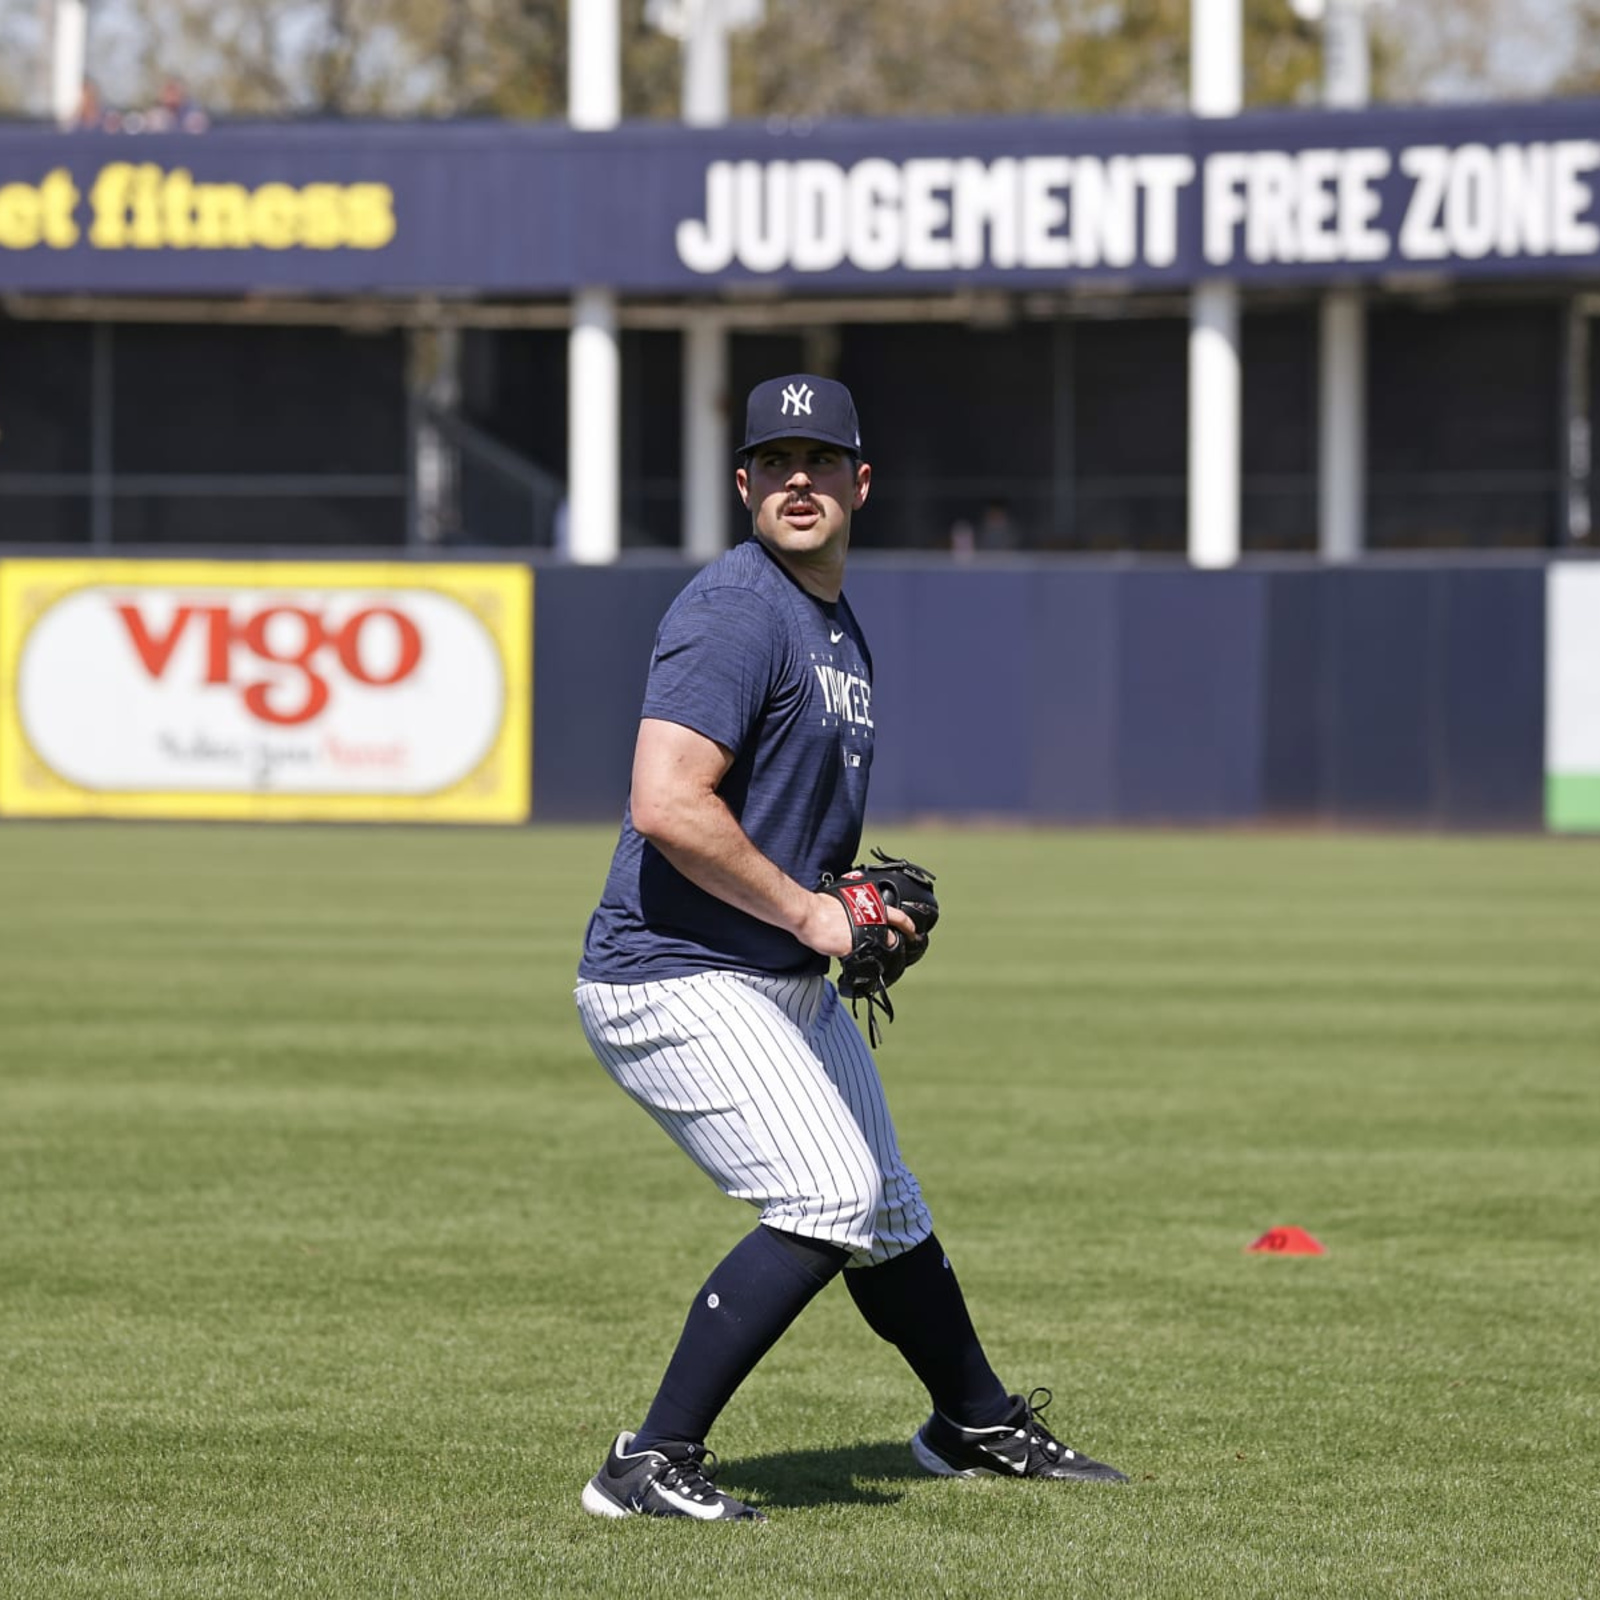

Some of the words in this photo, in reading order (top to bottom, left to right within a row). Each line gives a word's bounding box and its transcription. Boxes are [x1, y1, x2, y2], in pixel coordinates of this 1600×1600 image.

[89, 161, 396, 250] fitness
[677, 155, 1195, 273] JUDGEMENT
[1203, 147, 1392, 265] FREE
[1398, 139, 1600, 260] ZONE
[781, 383, 815, 416] NY
